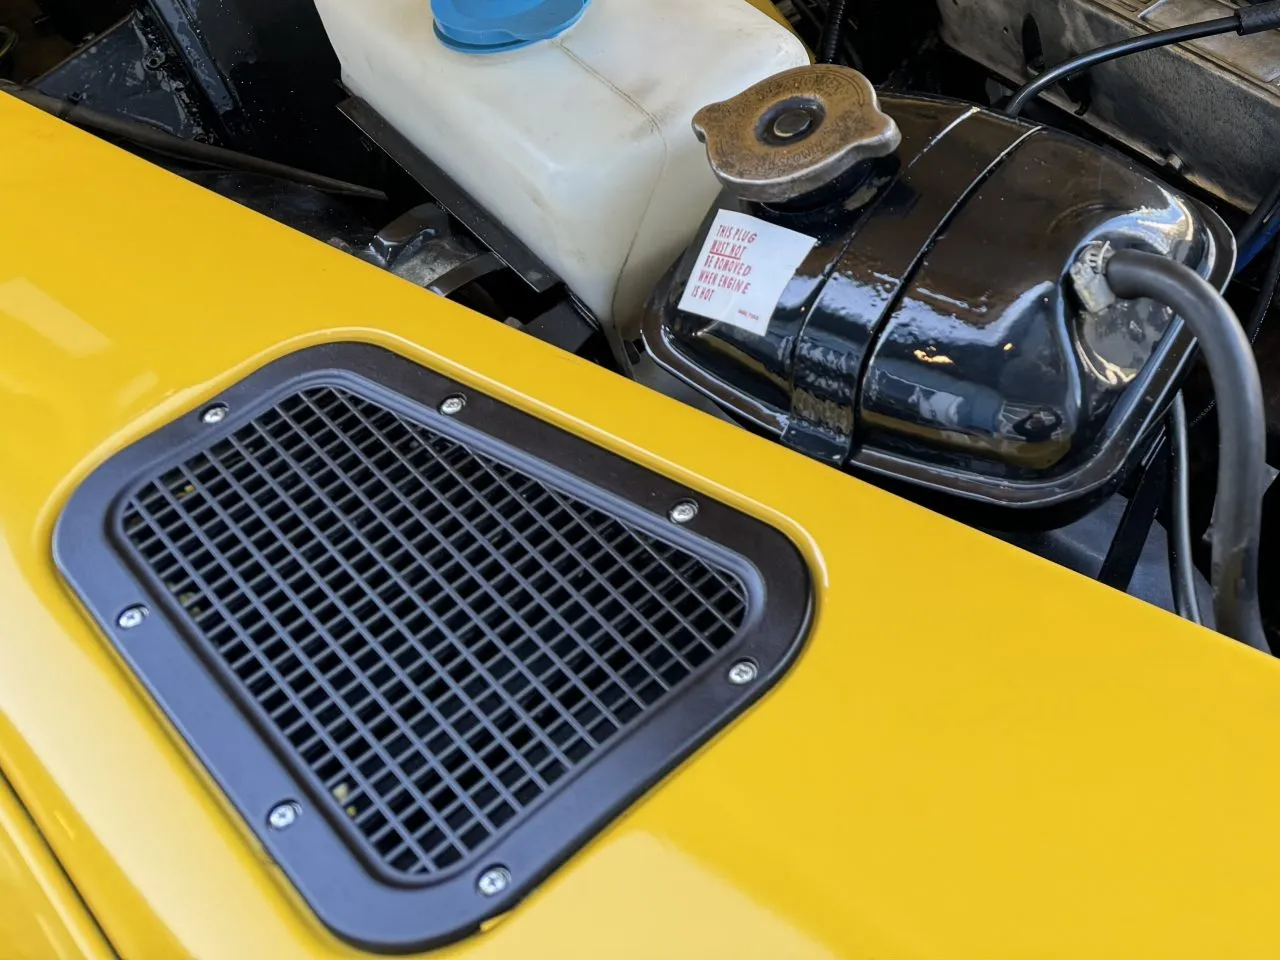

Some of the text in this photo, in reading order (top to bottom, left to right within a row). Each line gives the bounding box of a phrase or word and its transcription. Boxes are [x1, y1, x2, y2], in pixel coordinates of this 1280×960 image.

[716, 224, 757, 243] THIS PLUG
[711, 240, 748, 257] MUST NOT
[704, 255, 714, 268] BE
[698, 270, 751, 294] WHEN ENGINE
[691, 286, 715, 301] IS HOT
